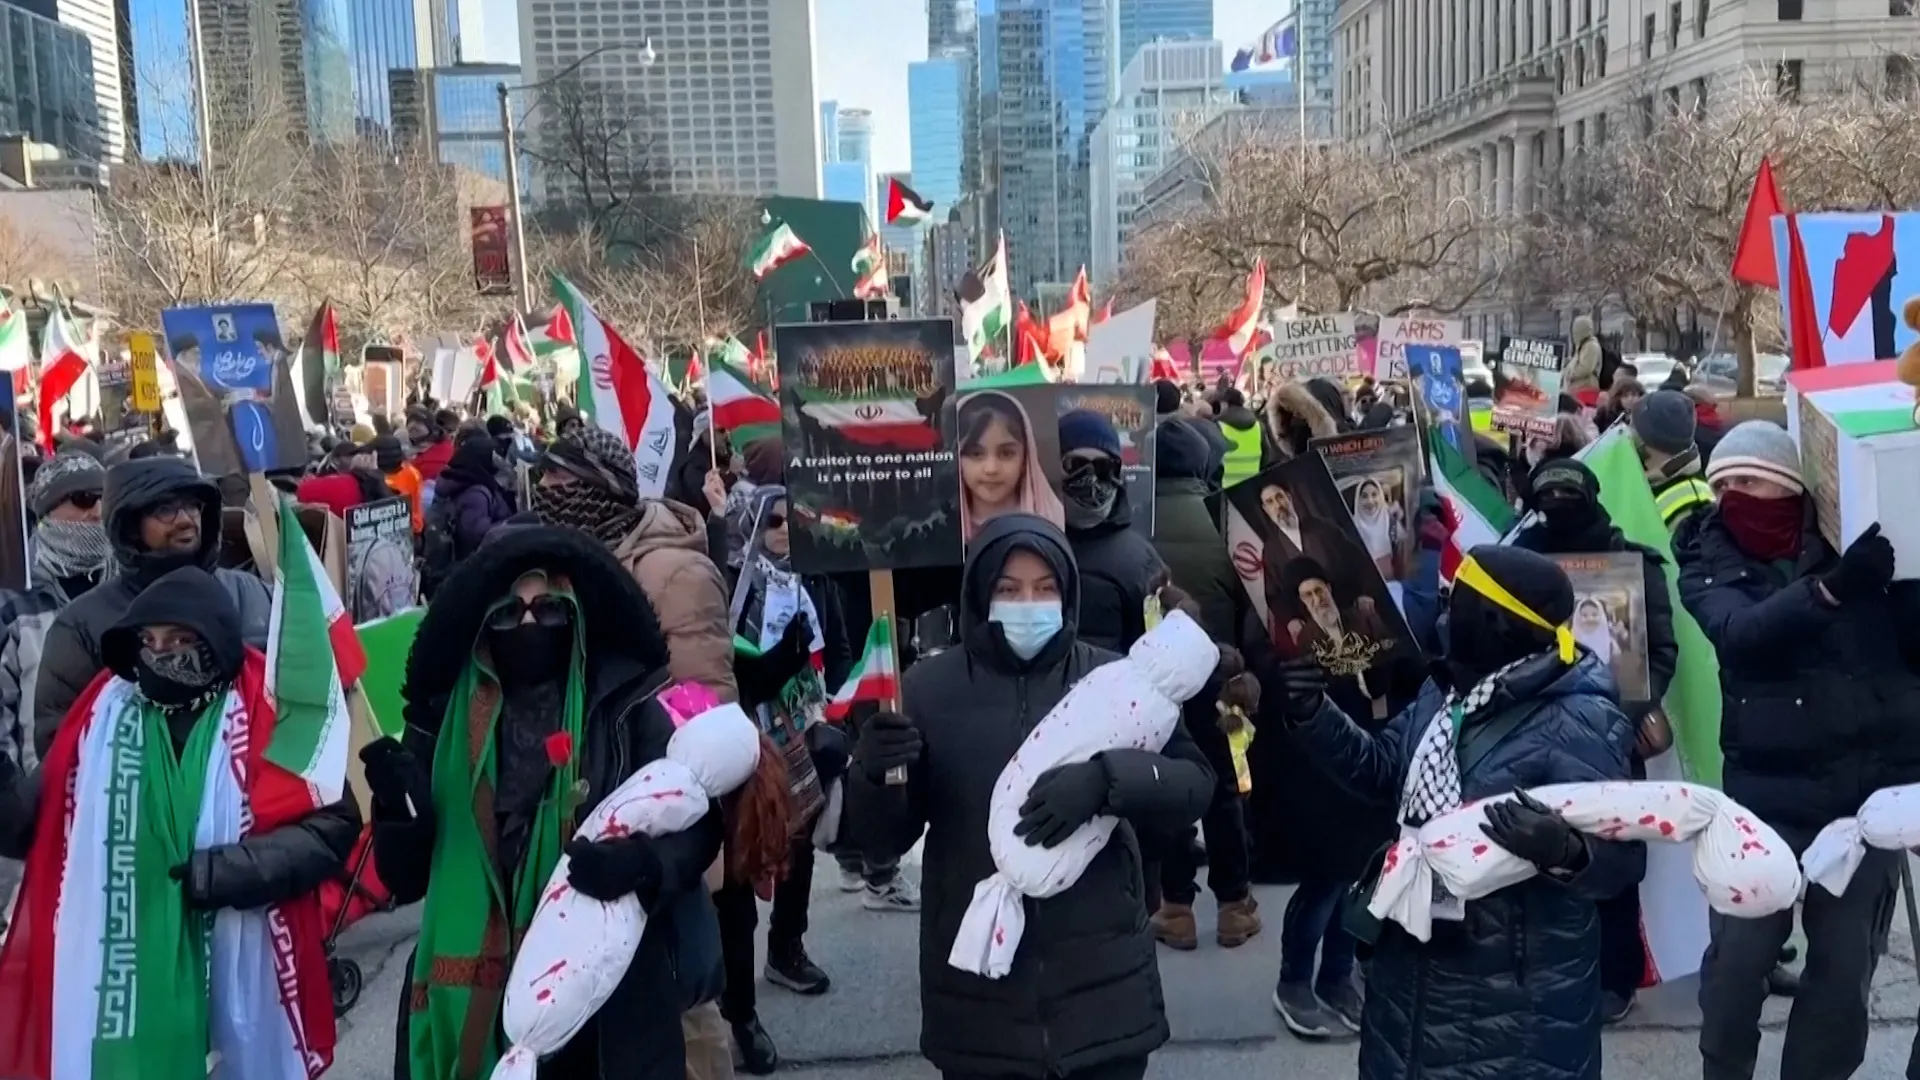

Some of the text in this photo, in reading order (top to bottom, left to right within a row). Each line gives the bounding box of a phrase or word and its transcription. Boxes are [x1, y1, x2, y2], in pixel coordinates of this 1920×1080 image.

[1286, 318, 1341, 339] ISRAEL
[1395, 321, 1445, 340] ARMS
[1275, 334, 1357, 359] COMMITTING
[1510, 339, 1554, 355] END GAZA
[1279, 353, 1358, 379] GENOCIDE
[1503, 348, 1558, 369] GENOCIDE
[790, 450, 953, 468] A traitor to one nation
[833, 473, 841, 482] a
[845, 468, 891, 482] traitor
[895, 469, 910, 479] to
[914, 467, 932, 478] all
